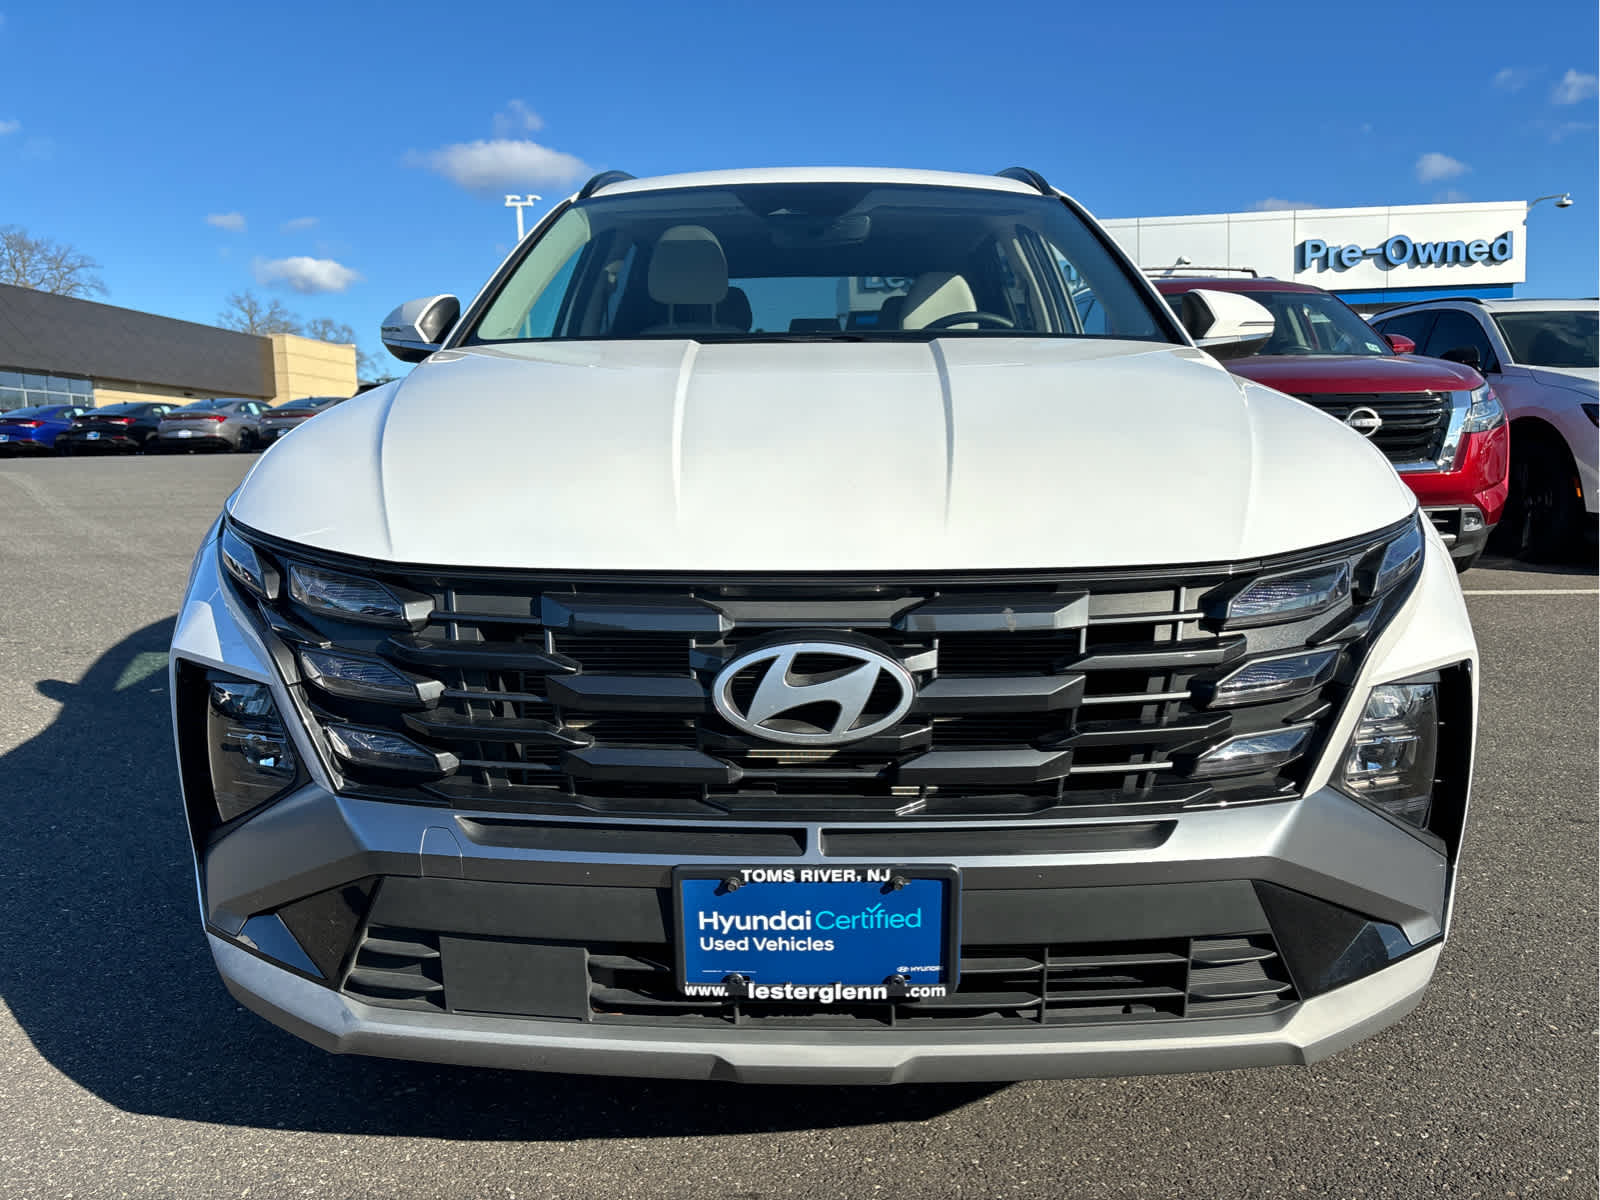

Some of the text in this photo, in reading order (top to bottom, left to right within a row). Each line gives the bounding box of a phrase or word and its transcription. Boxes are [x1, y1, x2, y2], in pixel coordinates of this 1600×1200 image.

[1299, 231, 1514, 271] Pre-Owned
[741, 869, 891, 883] TOMS RIVER, NJ
[698, 903, 922, 934] Hyundai Certified
[699, 936, 835, 952] Used Vehicles
[684, 983, 947, 1003] www. lesterglenn .com
